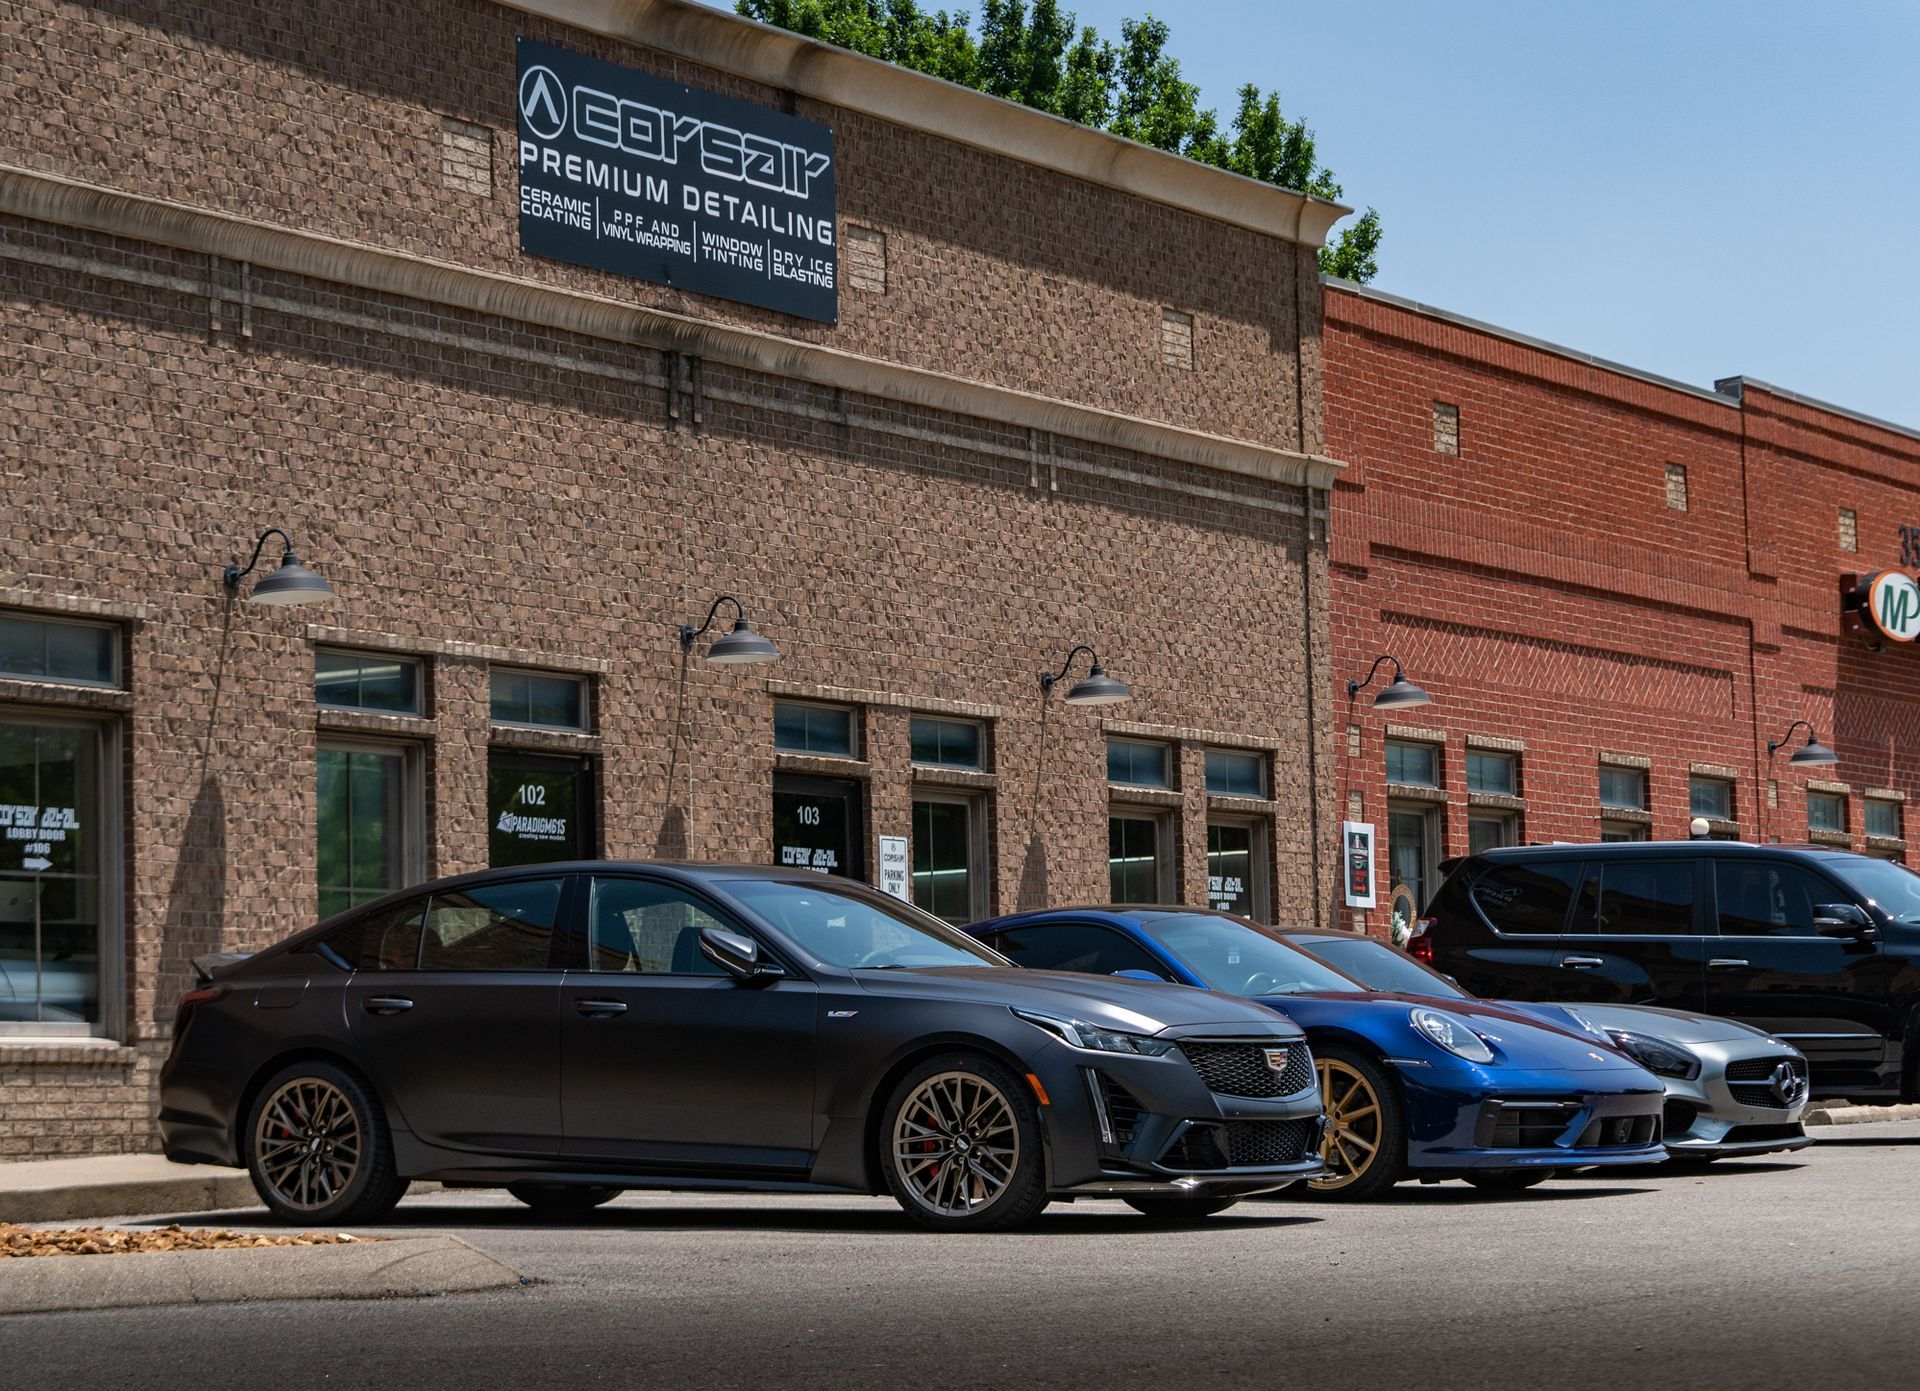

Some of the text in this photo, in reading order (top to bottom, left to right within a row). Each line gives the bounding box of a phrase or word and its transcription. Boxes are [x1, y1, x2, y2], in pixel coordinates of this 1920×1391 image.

[520, 139, 832, 246] PREMIUM DETAILING
[520, 185, 592, 216] CERAMIC
[520, 200, 592, 231] COATING
[602, 221, 691, 256] VINYL WRAPPING
[651, 219, 680, 238] AND
[701, 230, 764, 258] WINDOW
[701, 245, 764, 272] TINTING
[773, 248, 834, 276] DRY ICE
[773, 262, 834, 290] BLASTING
[518, 784, 546, 805] 102
[512, 815, 567, 834] PARADIGM615
[796, 805, 820, 826] 103
[6, 827, 66, 841] LOBBY DOOR
[24, 842, 51, 854] #106
[884, 869, 905, 881] PARKING
[888, 881, 901, 894] ONLY
